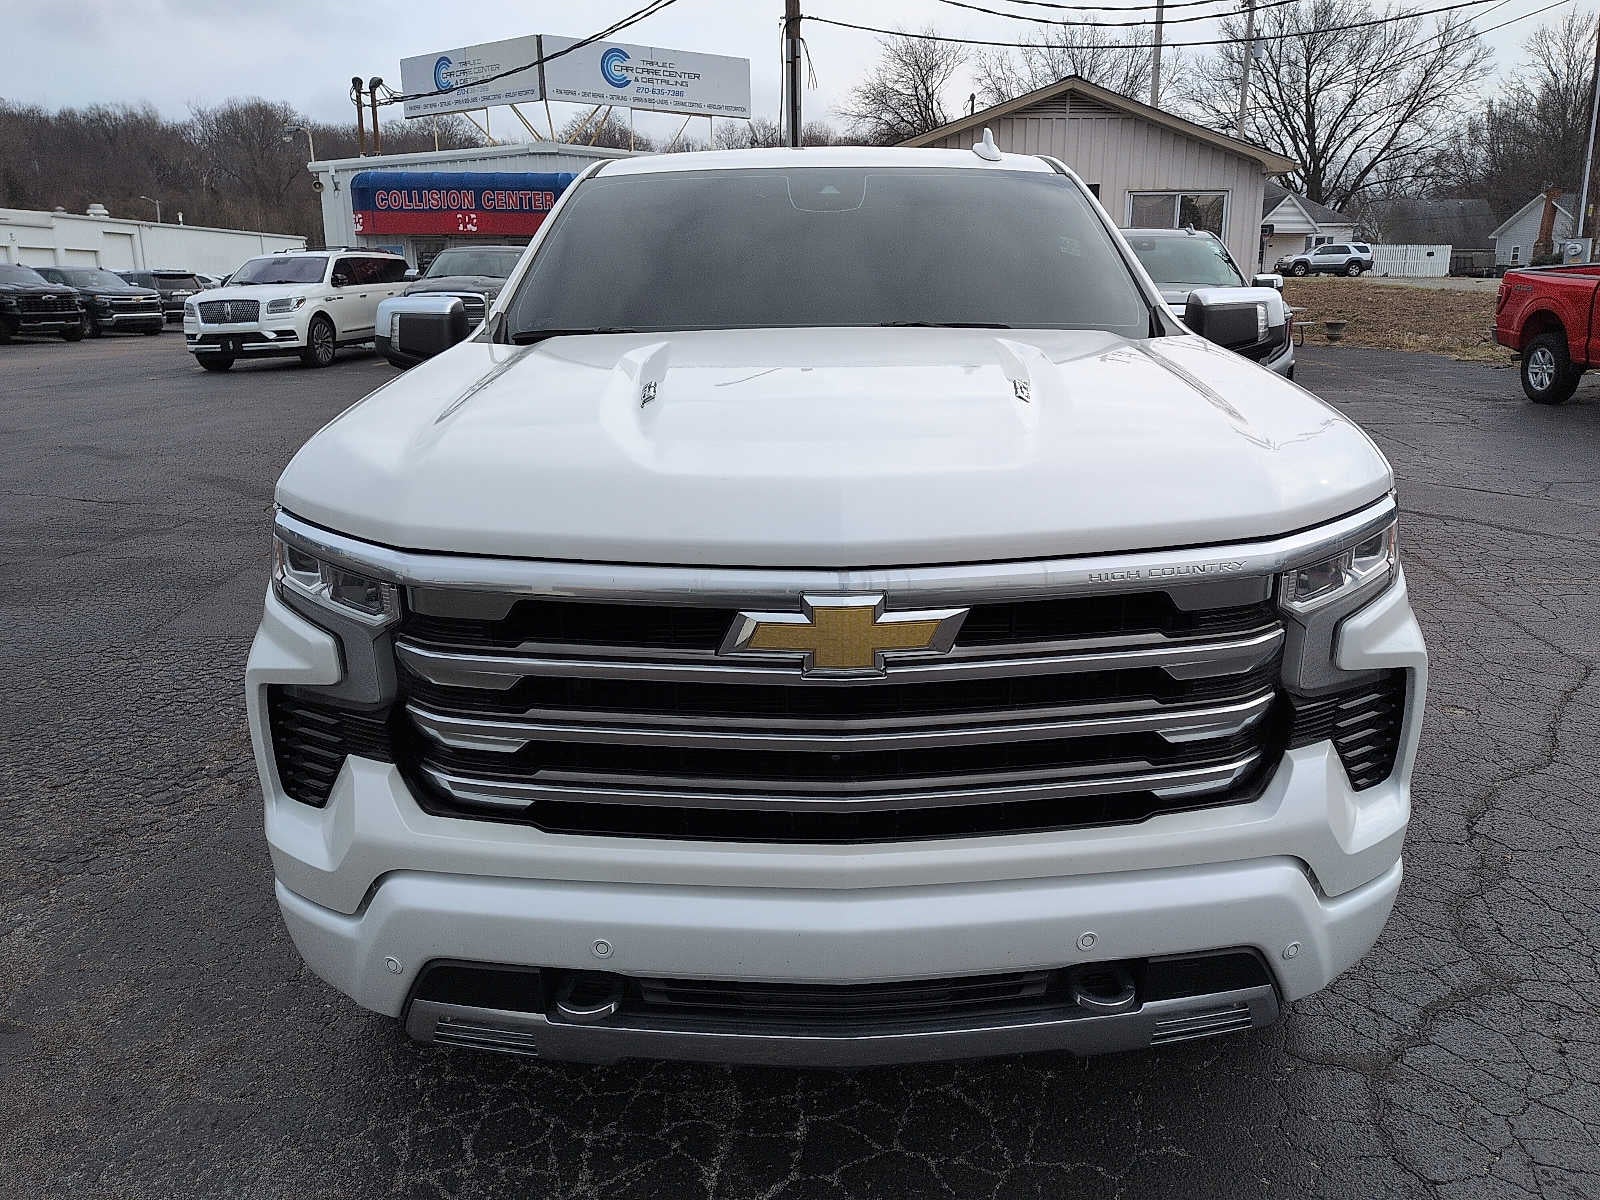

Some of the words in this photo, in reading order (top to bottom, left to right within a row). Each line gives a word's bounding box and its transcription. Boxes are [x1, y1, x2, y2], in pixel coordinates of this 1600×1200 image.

[613, 64, 634, 73] CAR
[635, 66, 661, 76] CARE
[662, 70, 701, 80] CENTER
[640, 59, 668, 69] TRIPLE
[641, 76, 689, 88] DETAILING
[375, 190, 475, 210] COLLISION
[481, 190, 555, 210] CENTER
[1088, 570, 1141, 584] HIGH
[1148, 560, 1247, 578] COUNTRY
